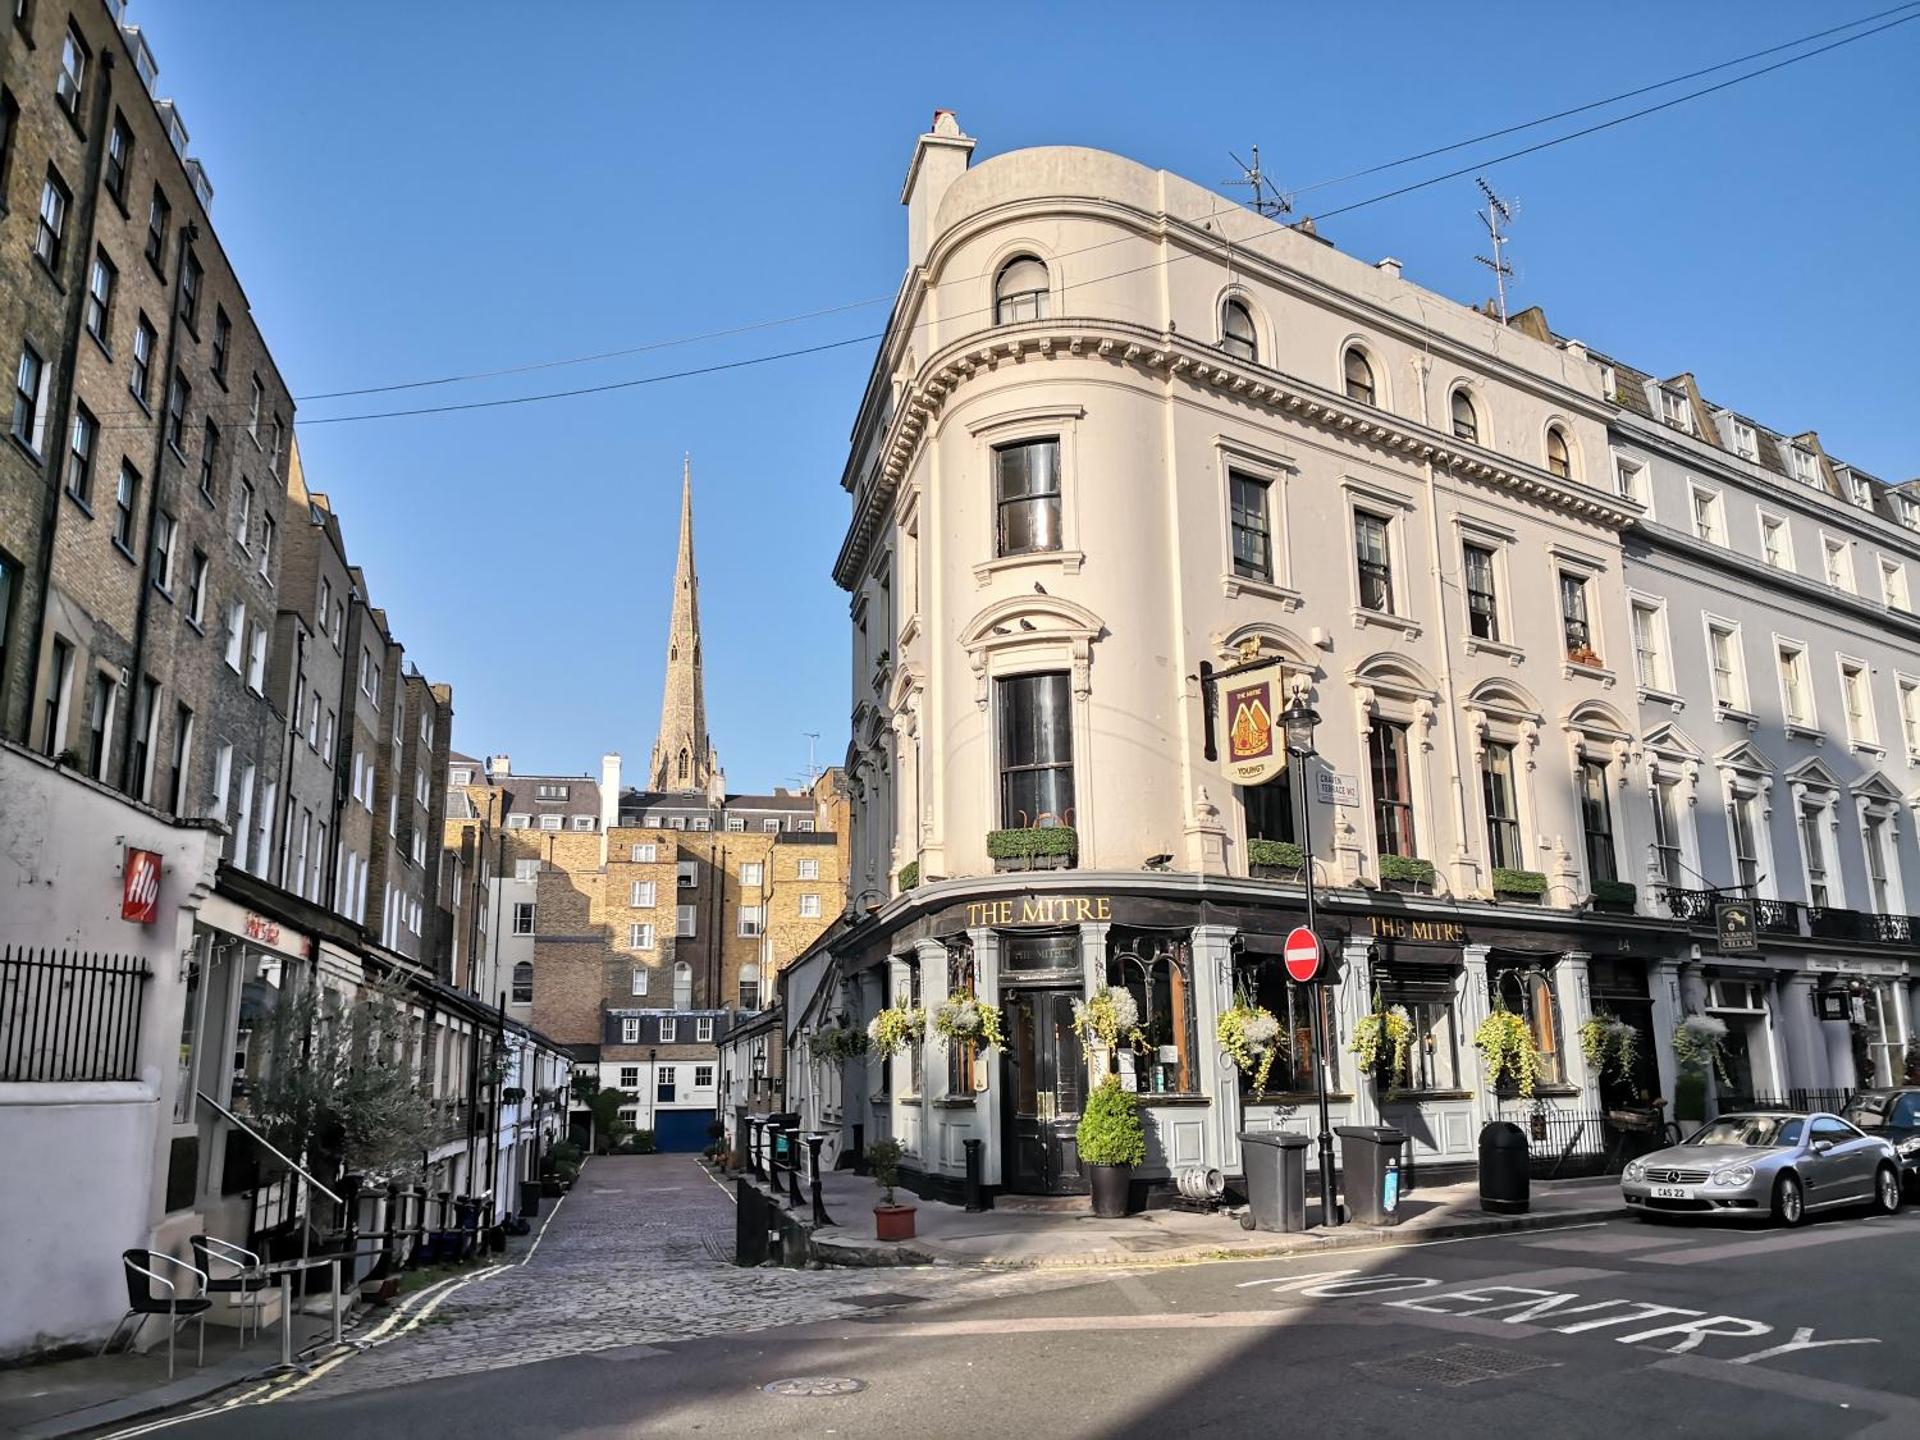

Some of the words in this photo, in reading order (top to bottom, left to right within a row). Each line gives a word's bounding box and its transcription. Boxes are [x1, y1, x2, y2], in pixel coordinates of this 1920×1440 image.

[128, 860, 159, 917] illy
[967, 901, 1013, 926] THE
[1022, 898, 1112, 923] MITRE
[1366, 916, 1406, 938] THE
[1412, 920, 1464, 942] MITRE
[1722, 940, 1753, 948] CELLAR
[1674, 1188, 1685, 1198] 22
[1236, 1269, 1443, 1298] NO
[1383, 1286, 1883, 1364] ENTRY
